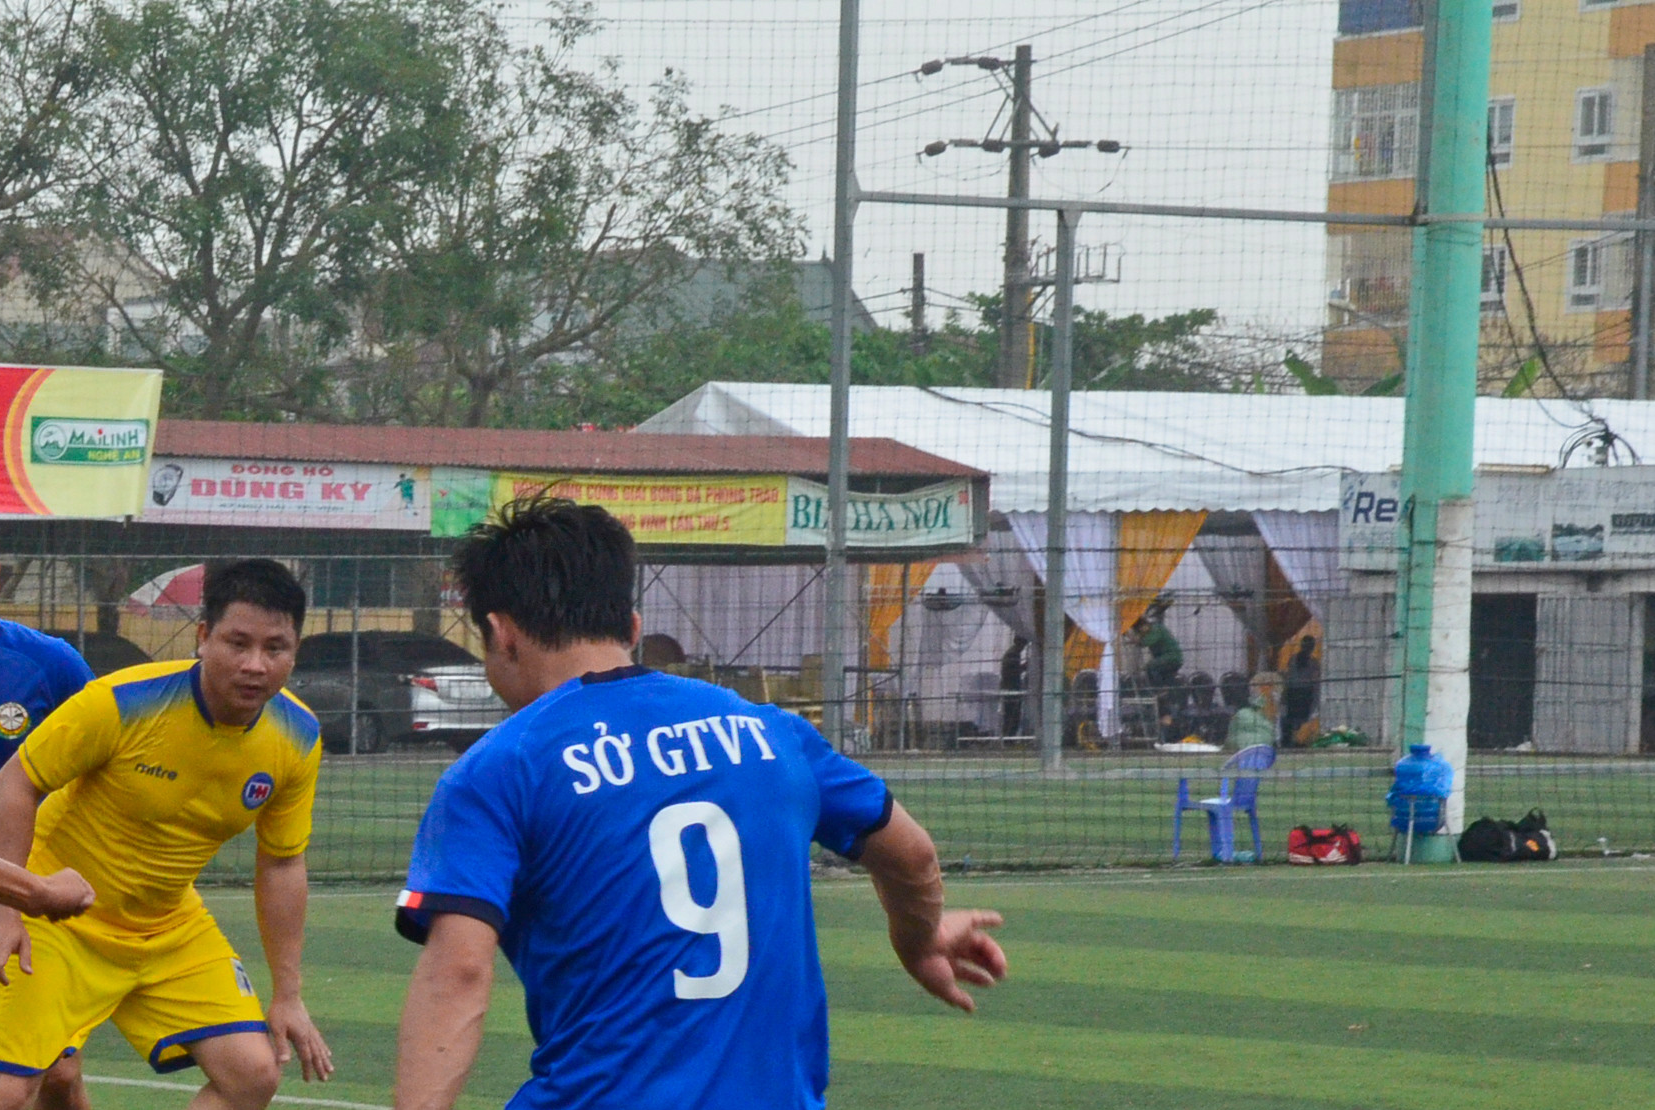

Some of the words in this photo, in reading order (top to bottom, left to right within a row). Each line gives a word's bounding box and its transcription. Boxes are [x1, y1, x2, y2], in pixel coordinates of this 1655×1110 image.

[562, 722, 635, 795] SỞ
[647, 715, 776, 777] GTVT
[649, 801, 749, 1000] 9
